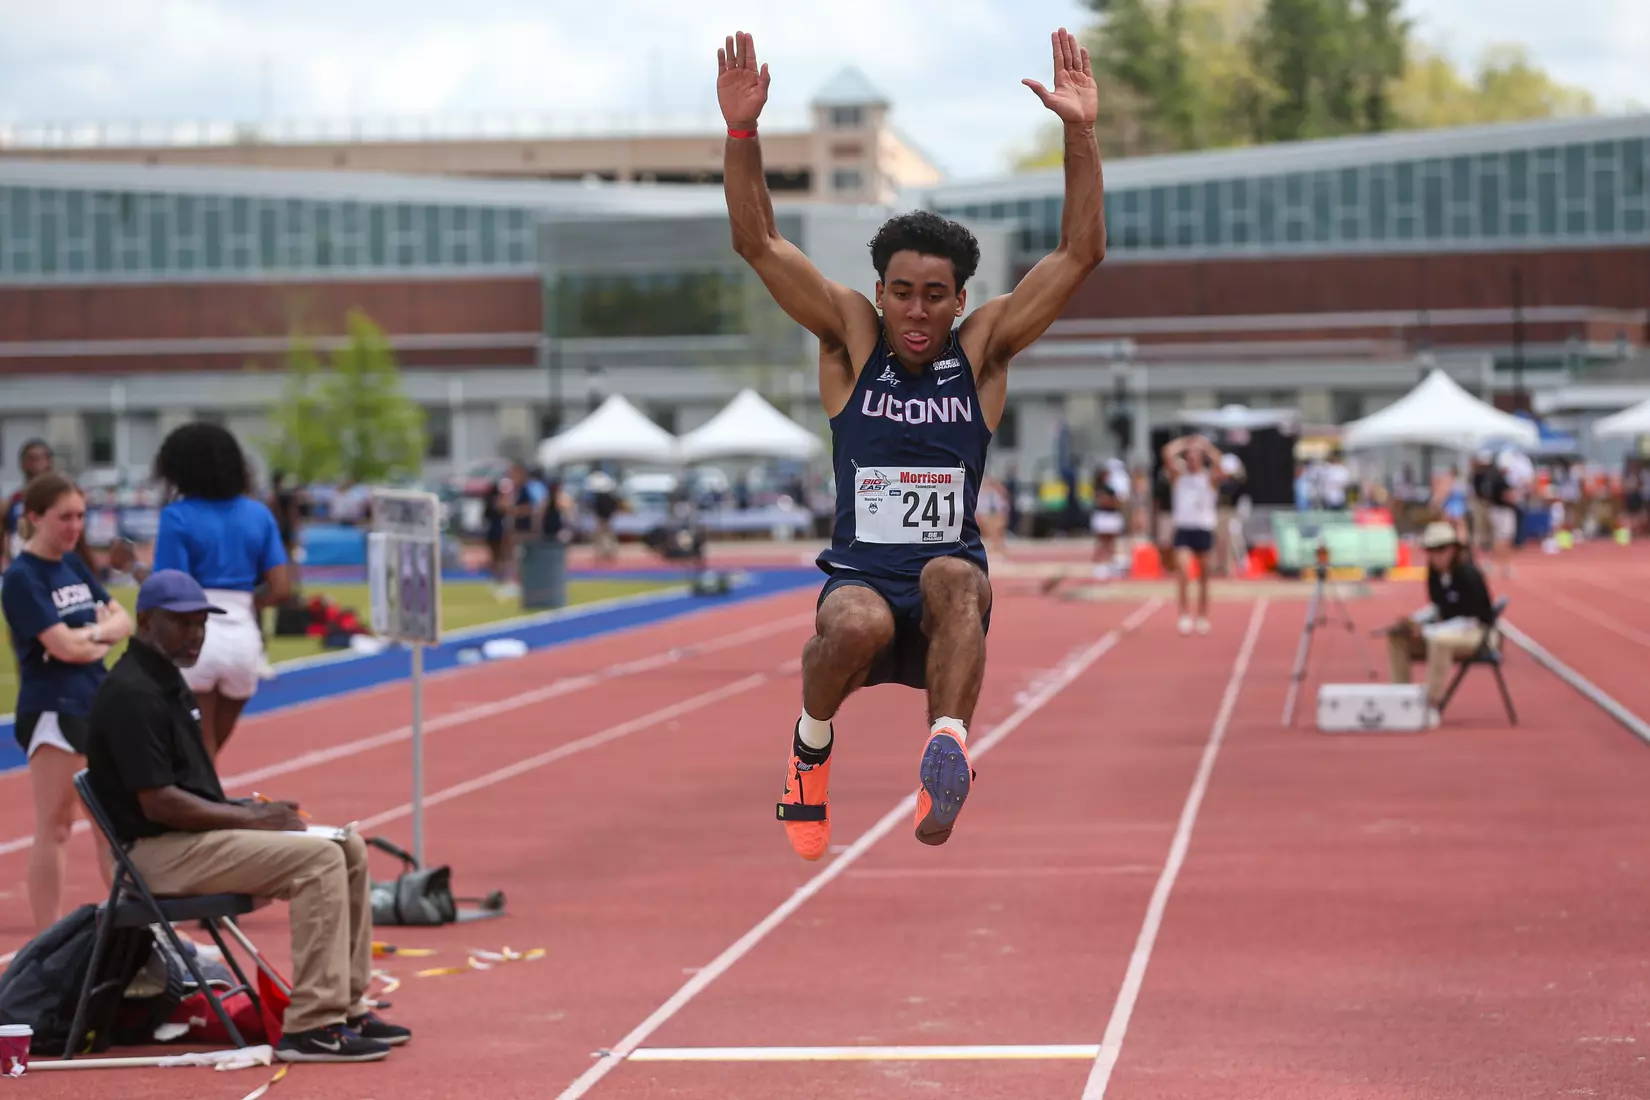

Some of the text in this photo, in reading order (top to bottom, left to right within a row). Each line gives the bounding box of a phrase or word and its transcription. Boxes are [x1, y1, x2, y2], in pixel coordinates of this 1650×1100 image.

[861, 389, 972, 424] UCONN
[900, 472, 952, 484] Morrison
[903, 491, 955, 527] 241
